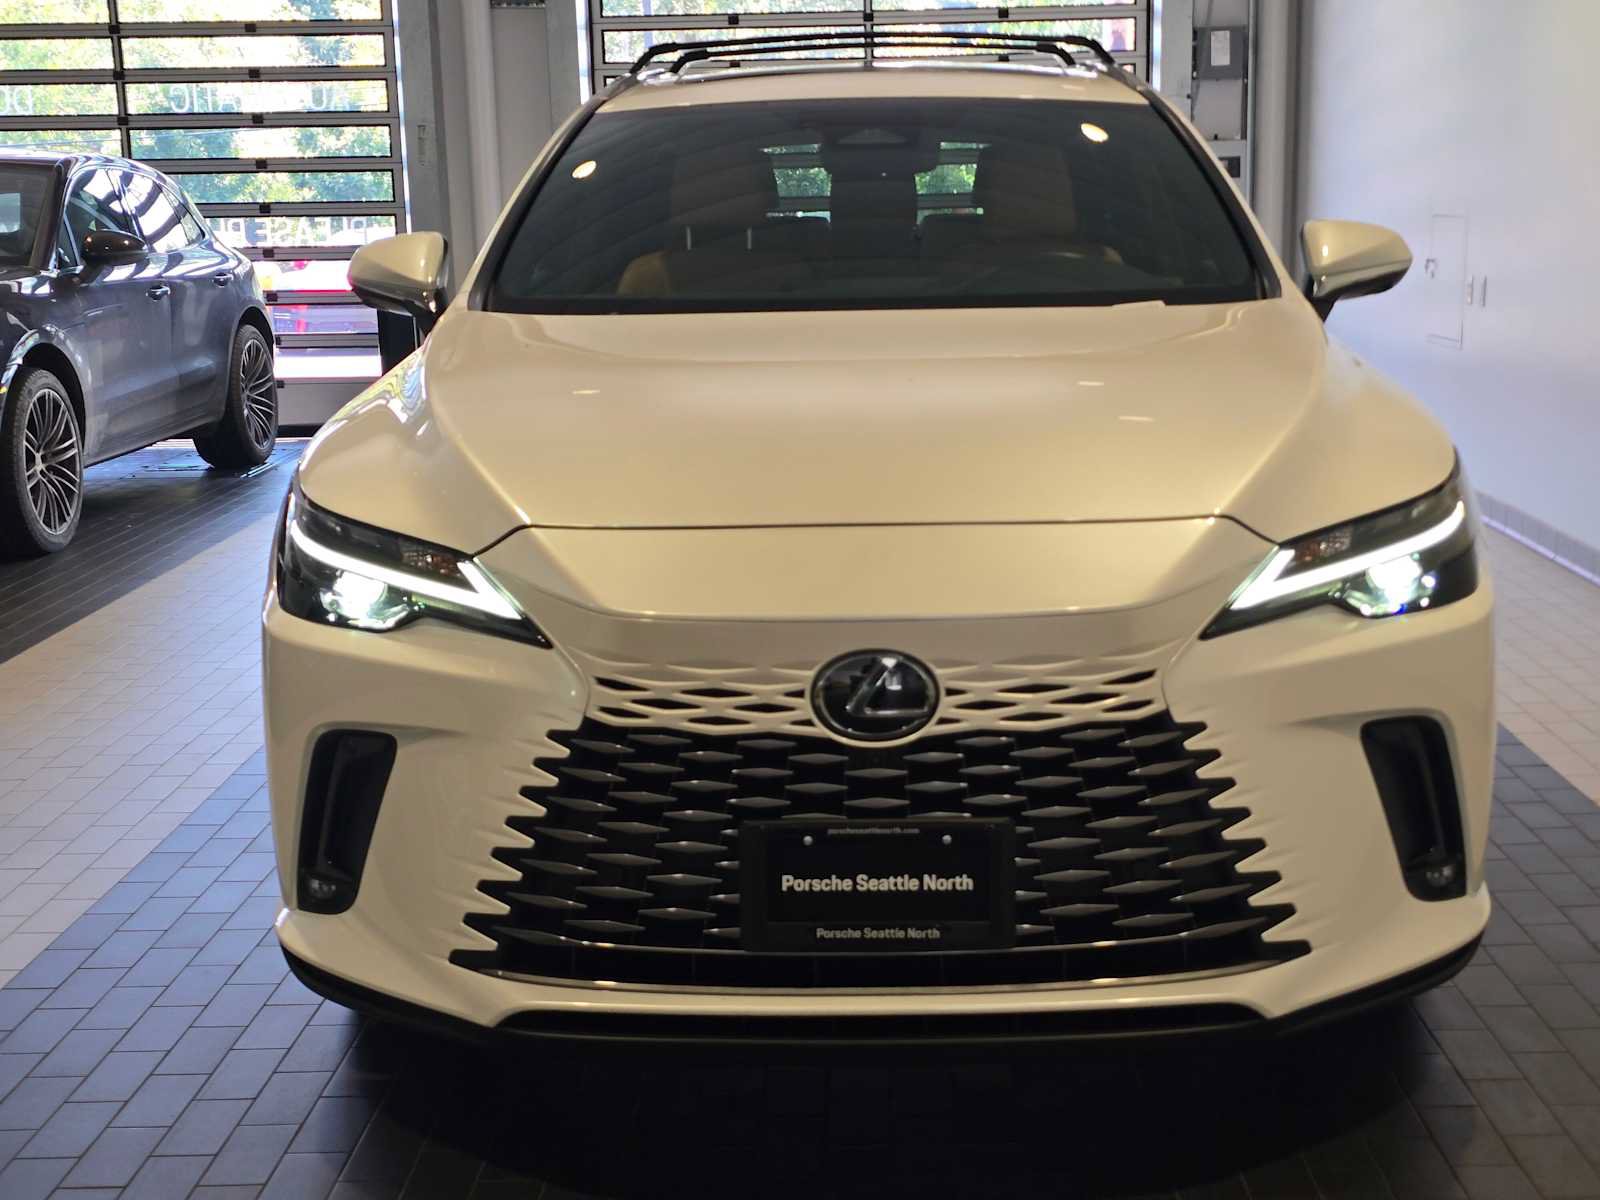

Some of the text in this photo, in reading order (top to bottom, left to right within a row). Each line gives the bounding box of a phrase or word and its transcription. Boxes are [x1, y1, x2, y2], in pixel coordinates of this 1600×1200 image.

[781, 873, 974, 892] Porsche Seattle North
[816, 927, 940, 939] Porsche Seattle North
